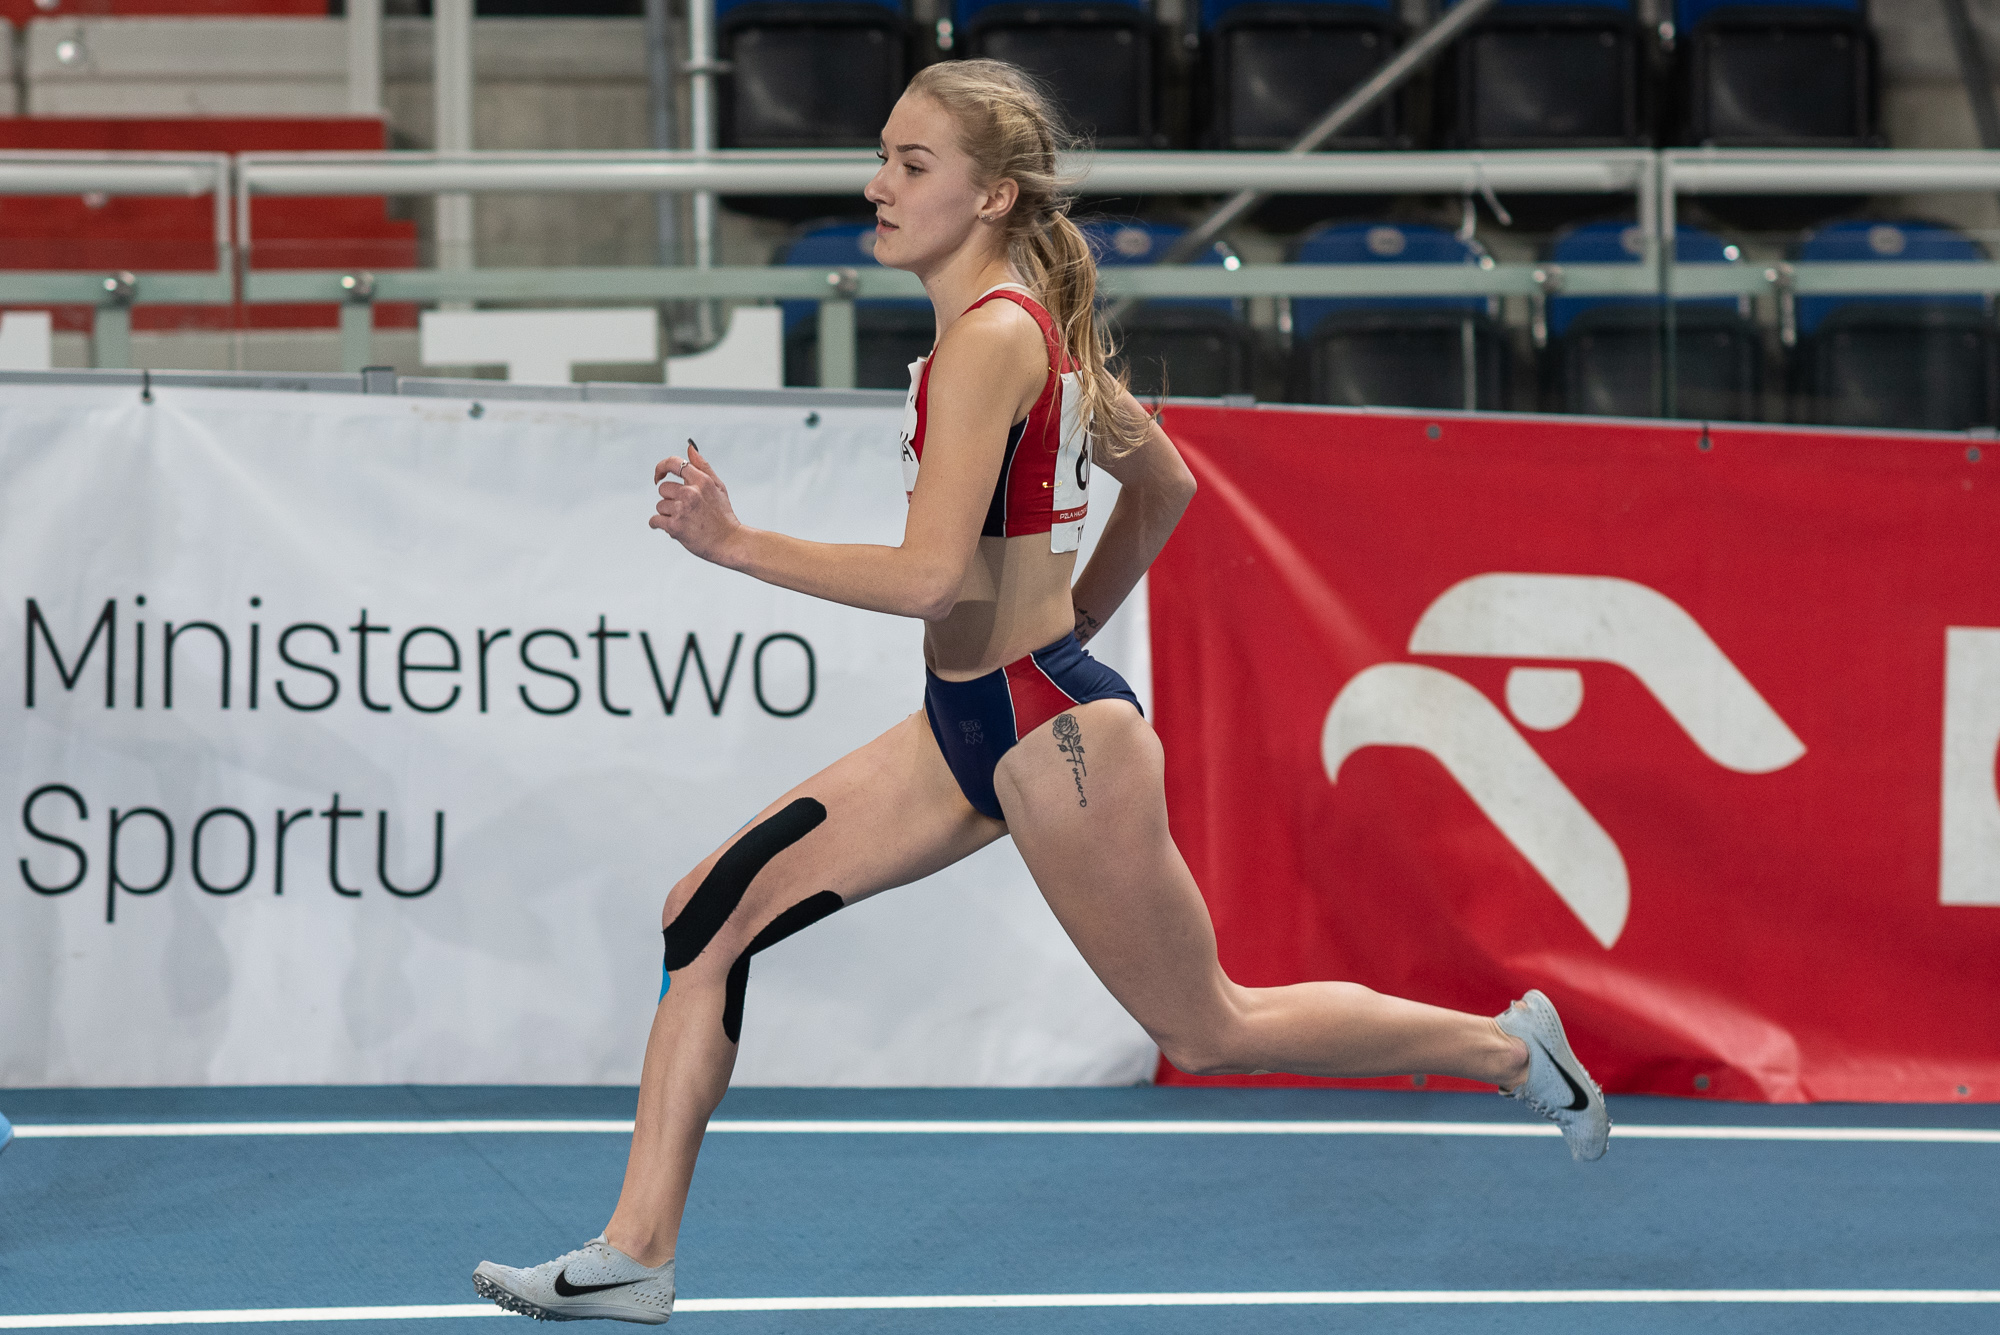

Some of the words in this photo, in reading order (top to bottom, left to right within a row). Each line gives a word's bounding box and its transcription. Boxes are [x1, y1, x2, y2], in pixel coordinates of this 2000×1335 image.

[1075, 425, 1090, 491] 6
[24, 594, 818, 719] Ministerstwo
[18, 782, 446, 924] Sportu
